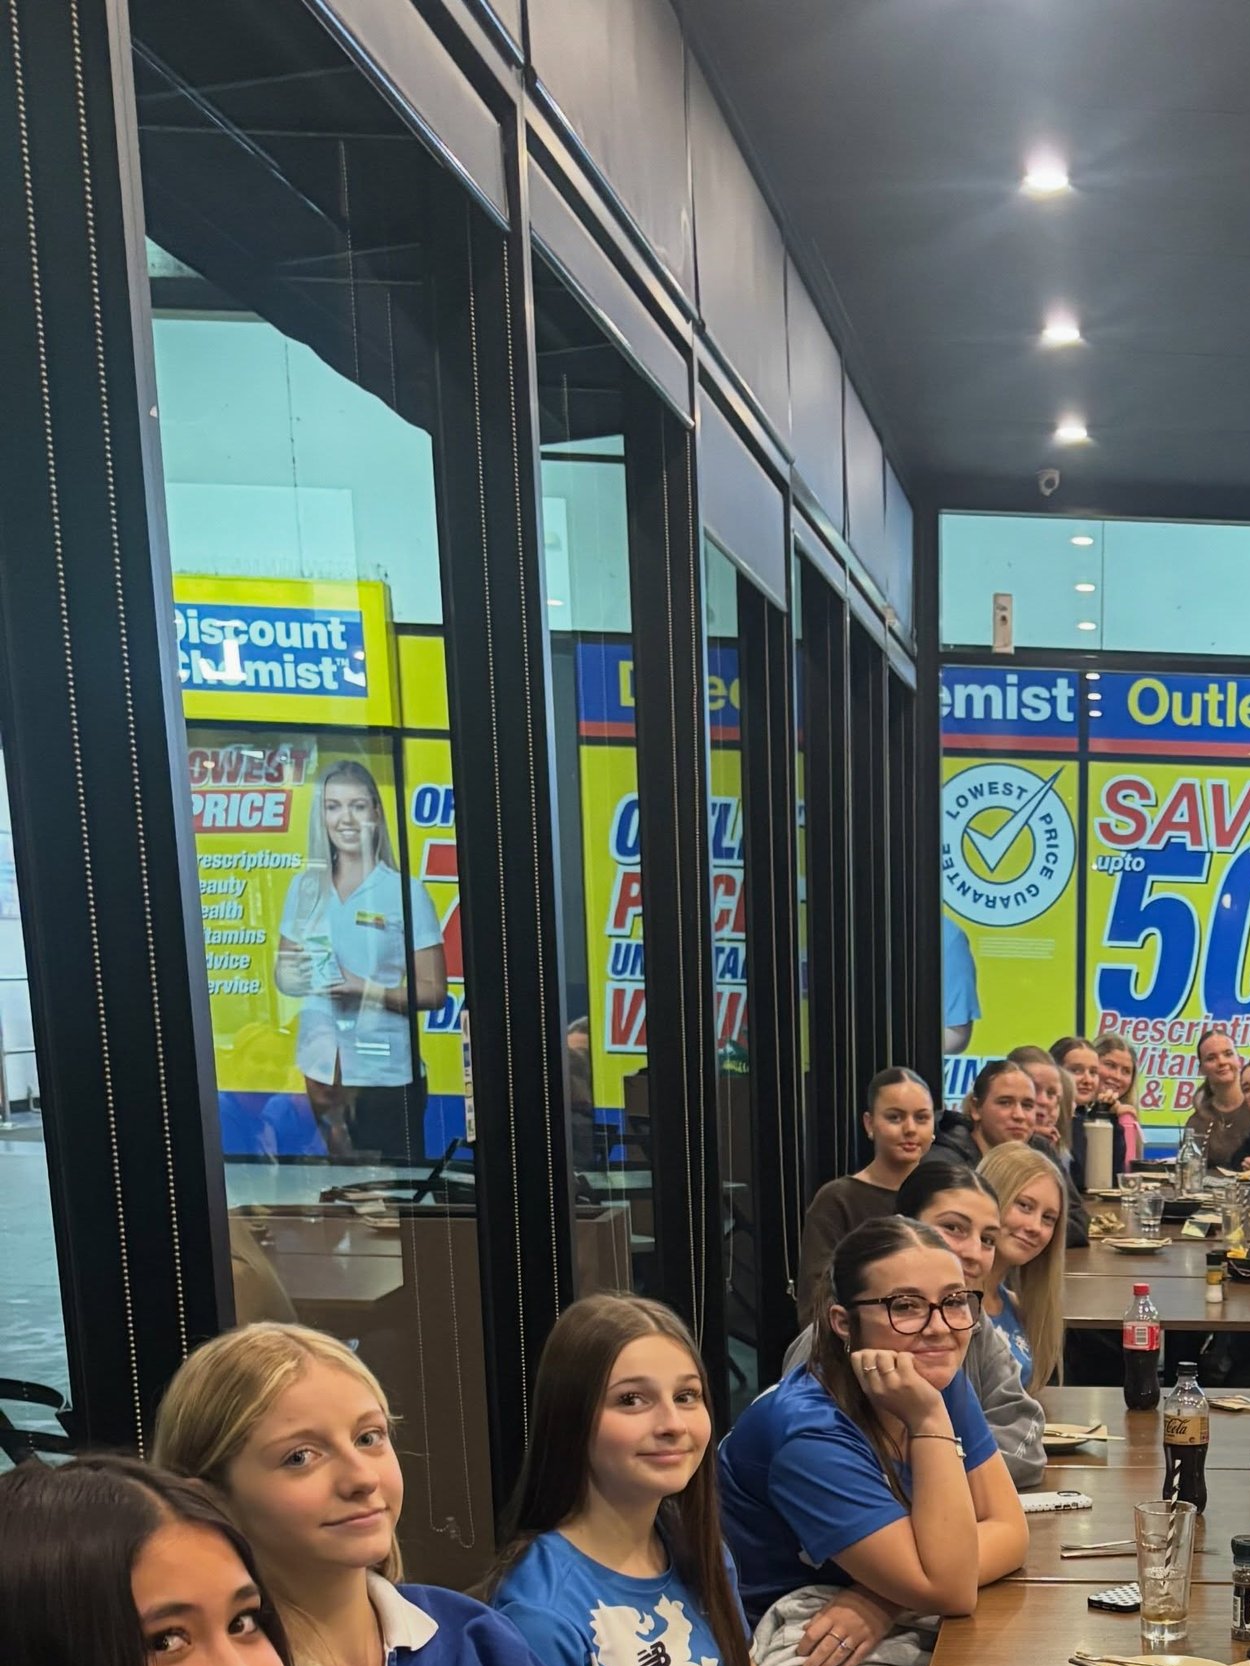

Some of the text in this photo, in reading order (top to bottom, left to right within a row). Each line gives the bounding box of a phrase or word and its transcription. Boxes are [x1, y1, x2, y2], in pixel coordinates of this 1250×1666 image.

[946, 781, 1028, 820] LOWEST
[942, 843, 1040, 909] GUARANTEE
[1039, 813, 1060, 880] PRICE
